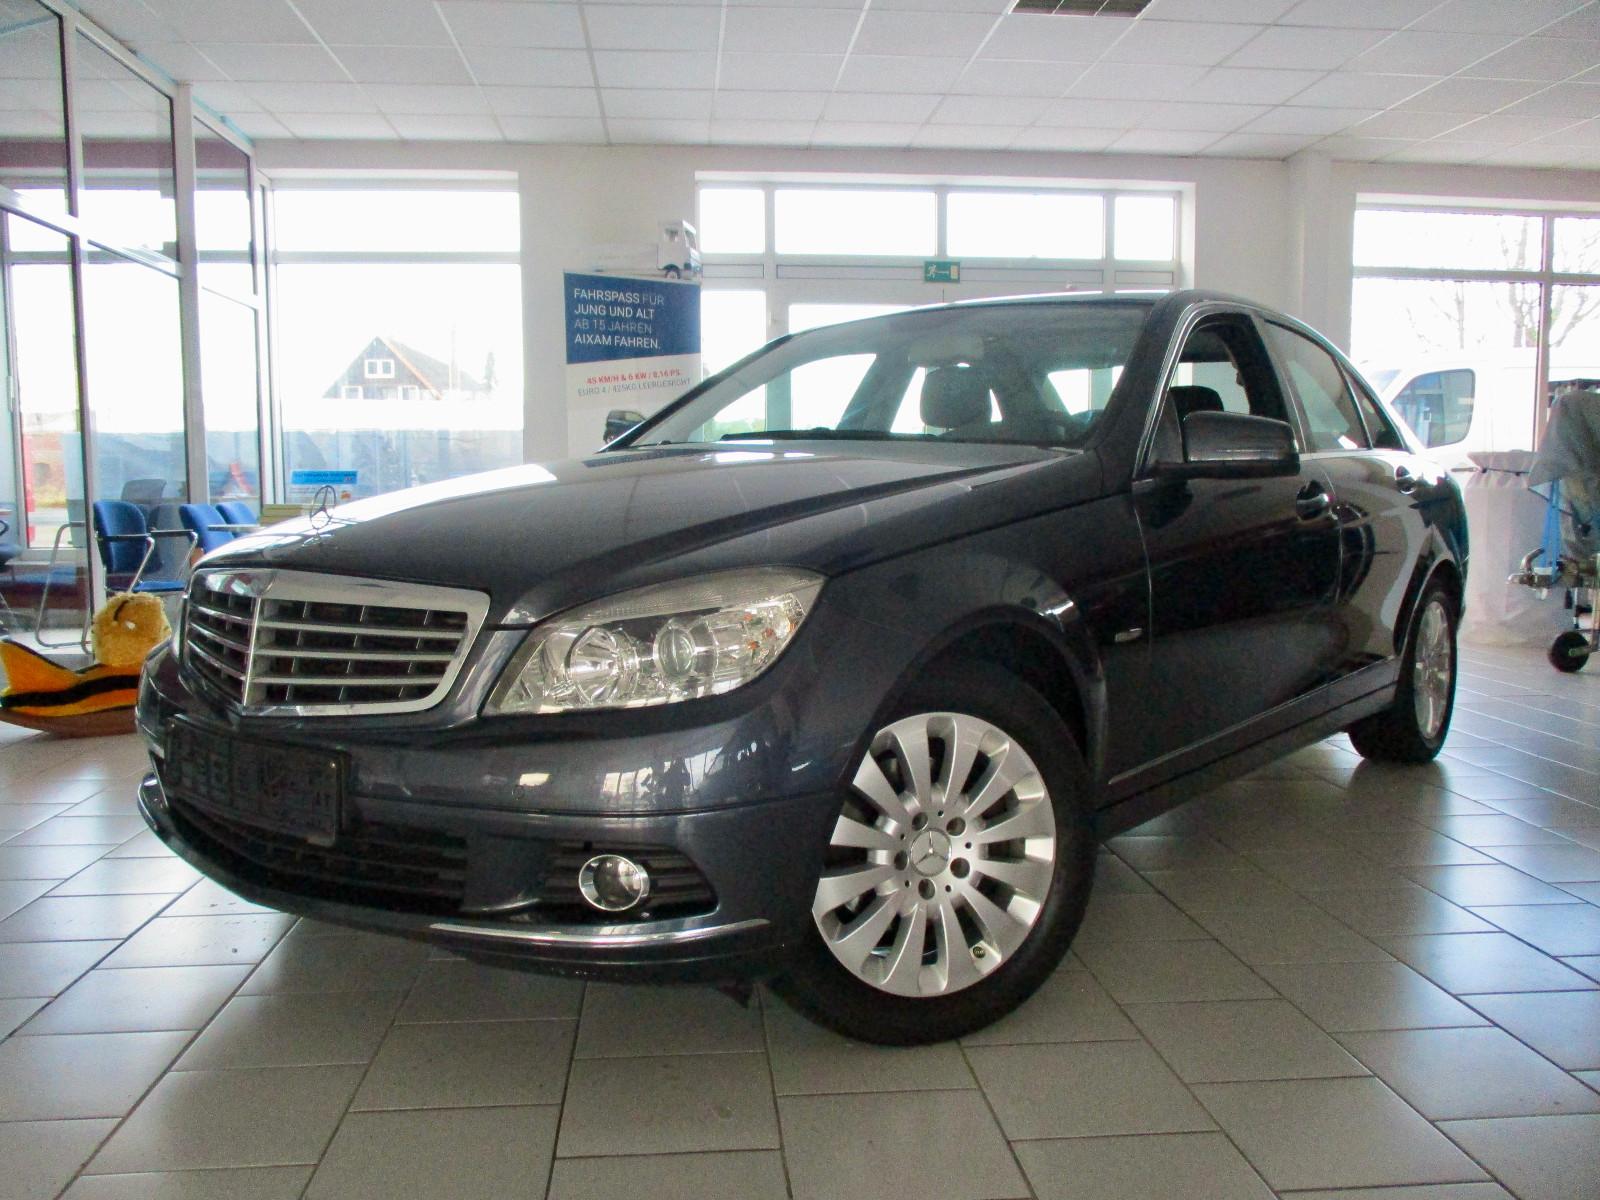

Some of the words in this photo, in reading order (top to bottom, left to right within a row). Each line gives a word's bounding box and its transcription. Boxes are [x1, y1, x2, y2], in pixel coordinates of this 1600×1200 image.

[574, 287, 640, 304] FAHRSPASS
[574, 303, 606, 316] JUNG
[609, 305, 633, 318] UND
[636, 308, 655, 319] ALT
[574, 318, 589, 330] AB
[593, 319, 606, 331] 15
[608, 320, 652, 334] JAHREN
[574, 333, 612, 345] AIXAM
[614, 335, 661, 350] FAHREN.
[598, 374, 619, 384] KM/H
[635, 371, 647, 380] KW
[578, 386, 600, 396] EURO
